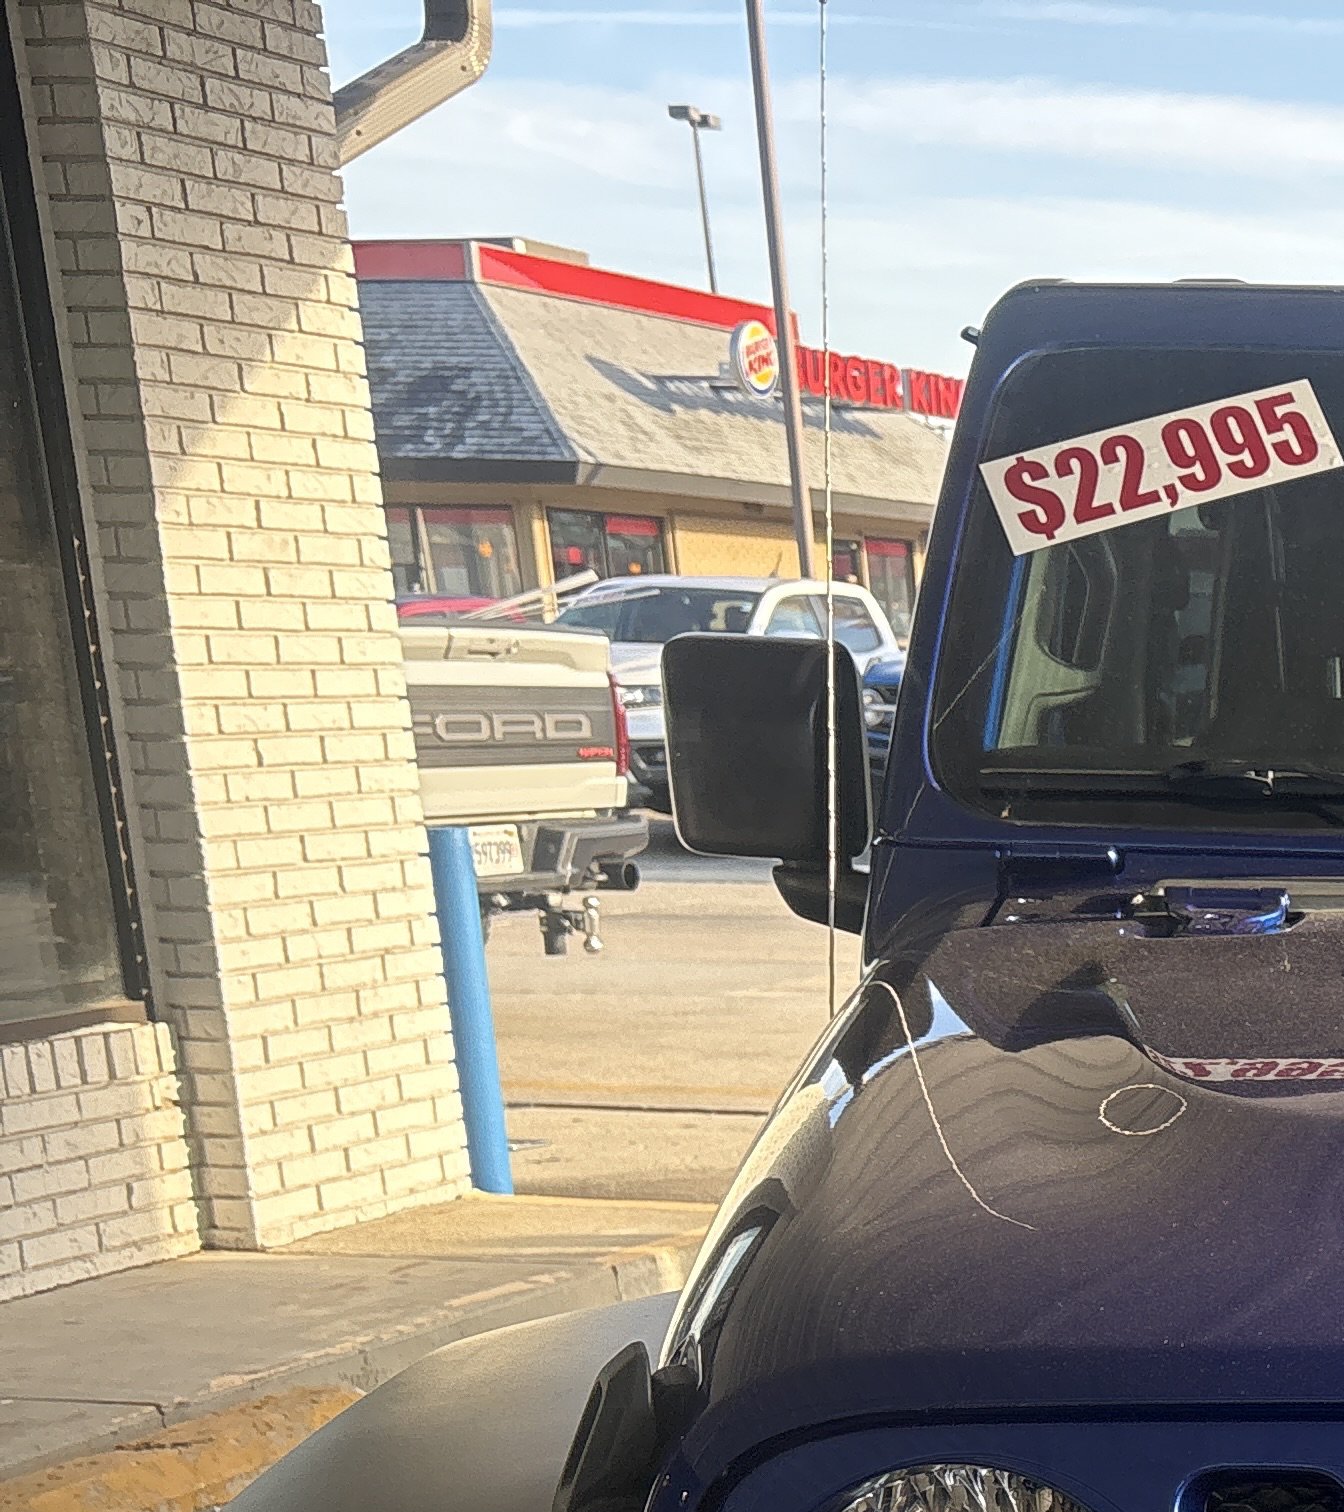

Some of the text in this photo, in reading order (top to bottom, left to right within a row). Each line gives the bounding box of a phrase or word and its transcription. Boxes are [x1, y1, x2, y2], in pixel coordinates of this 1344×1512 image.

[910, 368, 965, 421] KIN
[1004, 391, 1319, 541] $22,995
[413, 711, 593, 742] FORD
